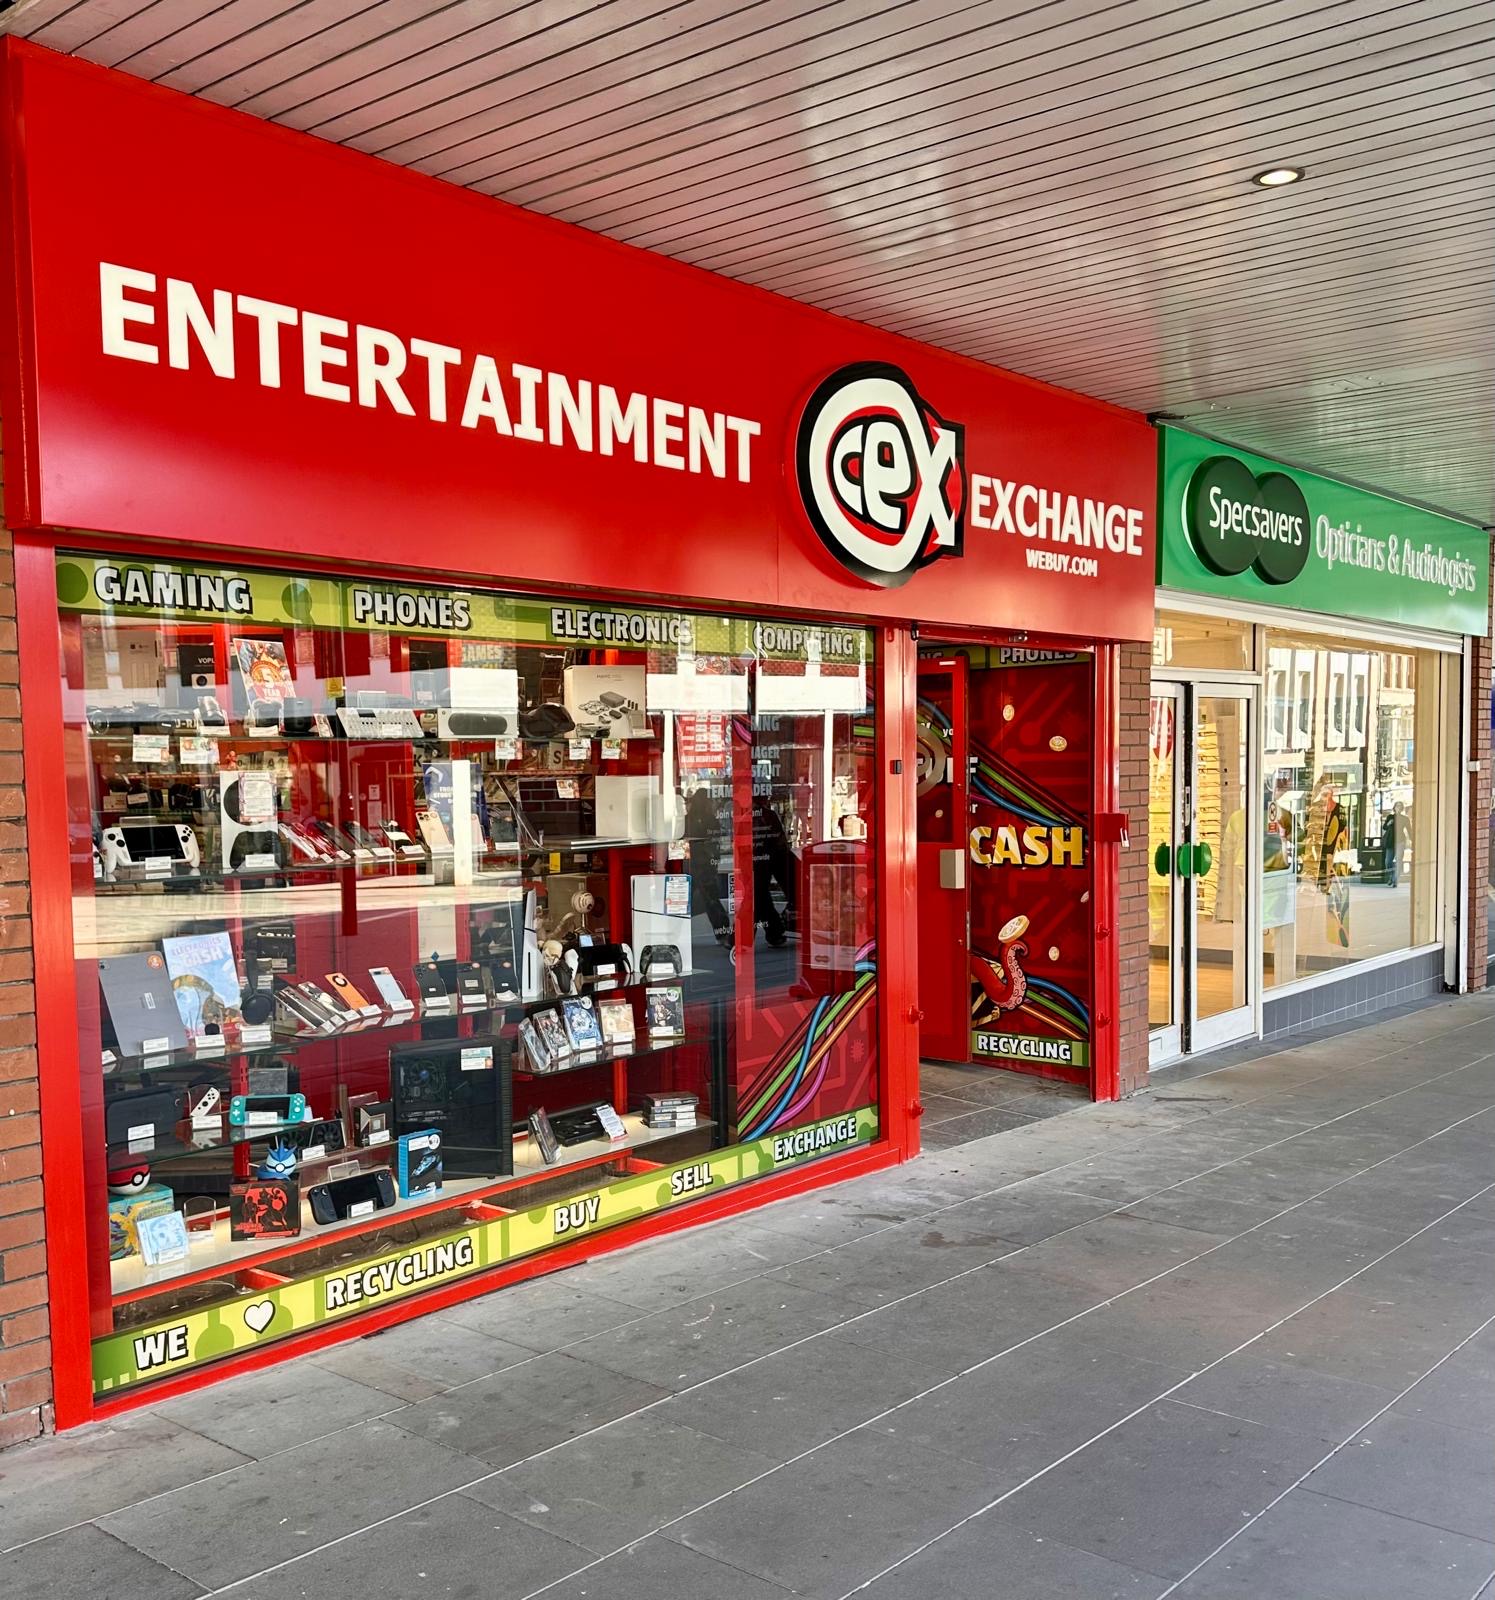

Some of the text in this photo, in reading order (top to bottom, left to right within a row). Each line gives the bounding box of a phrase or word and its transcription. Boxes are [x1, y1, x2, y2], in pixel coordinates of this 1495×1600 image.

[99, 261, 761, 483] ENTERTAINMENT
[971, 473, 1143, 556] EXCHANGE
[1209, 486, 1303, 546] Specsavers
[1026, 549, 1098, 577] WEBUY.COM
[1315, 514, 1476, 596] Opticians & Audiologists
[94, 566, 253, 614] GAMING
[353, 589, 471, 630] PHONES
[551, 608, 692, 644] ELECTRONICS
[970, 826, 1085, 869] CASH
[977, 1034, 1072, 1061] RECYCLING
[773, 1116, 858, 1164] EXCHANGE
[671, 1162, 713, 1196] SELL
[554, 1196, 601, 1233] BUY
[326, 1236, 473, 1310] RECYCLING
[133, 1324, 189, 1371] WE
